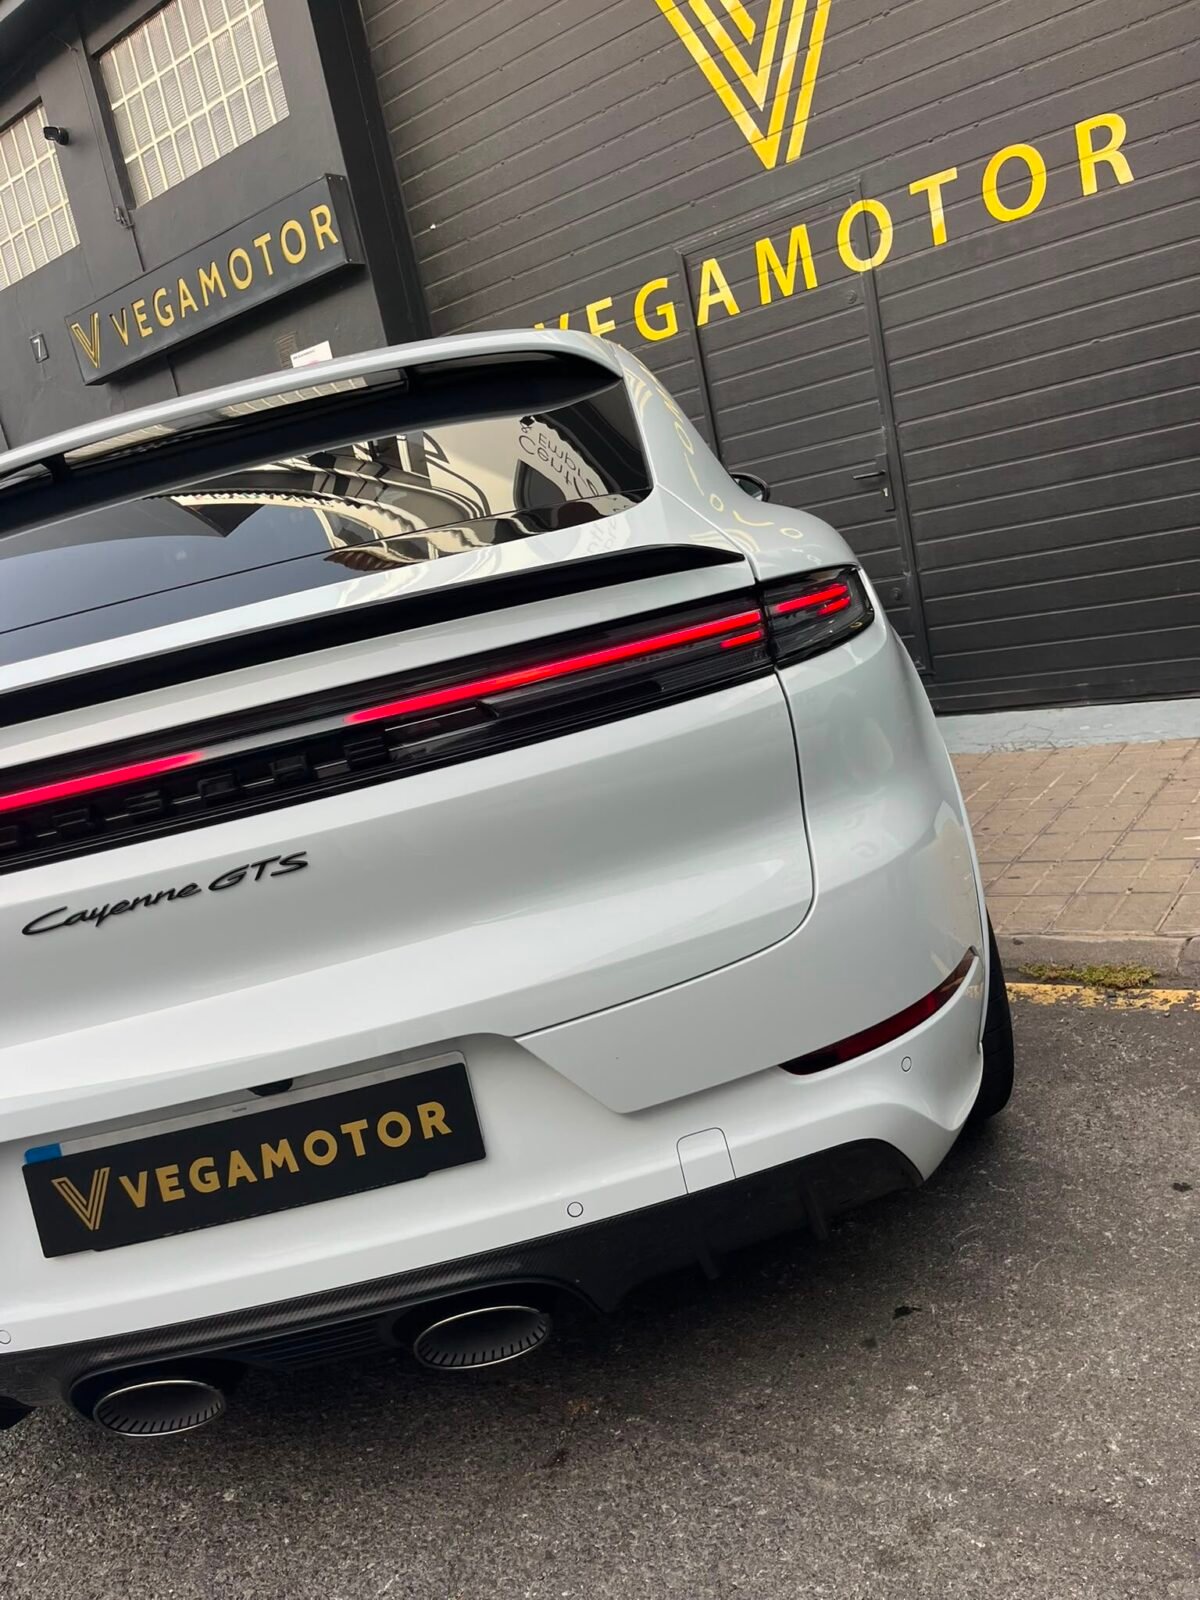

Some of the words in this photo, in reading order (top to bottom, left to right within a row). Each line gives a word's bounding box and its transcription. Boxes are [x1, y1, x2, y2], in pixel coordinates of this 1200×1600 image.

[109, 203, 339, 346] VEGAMOTOR
[22, 882, 201, 936] Cayenne
[208, 851, 309, 892] GTS
[119, 1101, 452, 1209] VEGAMOTOR
